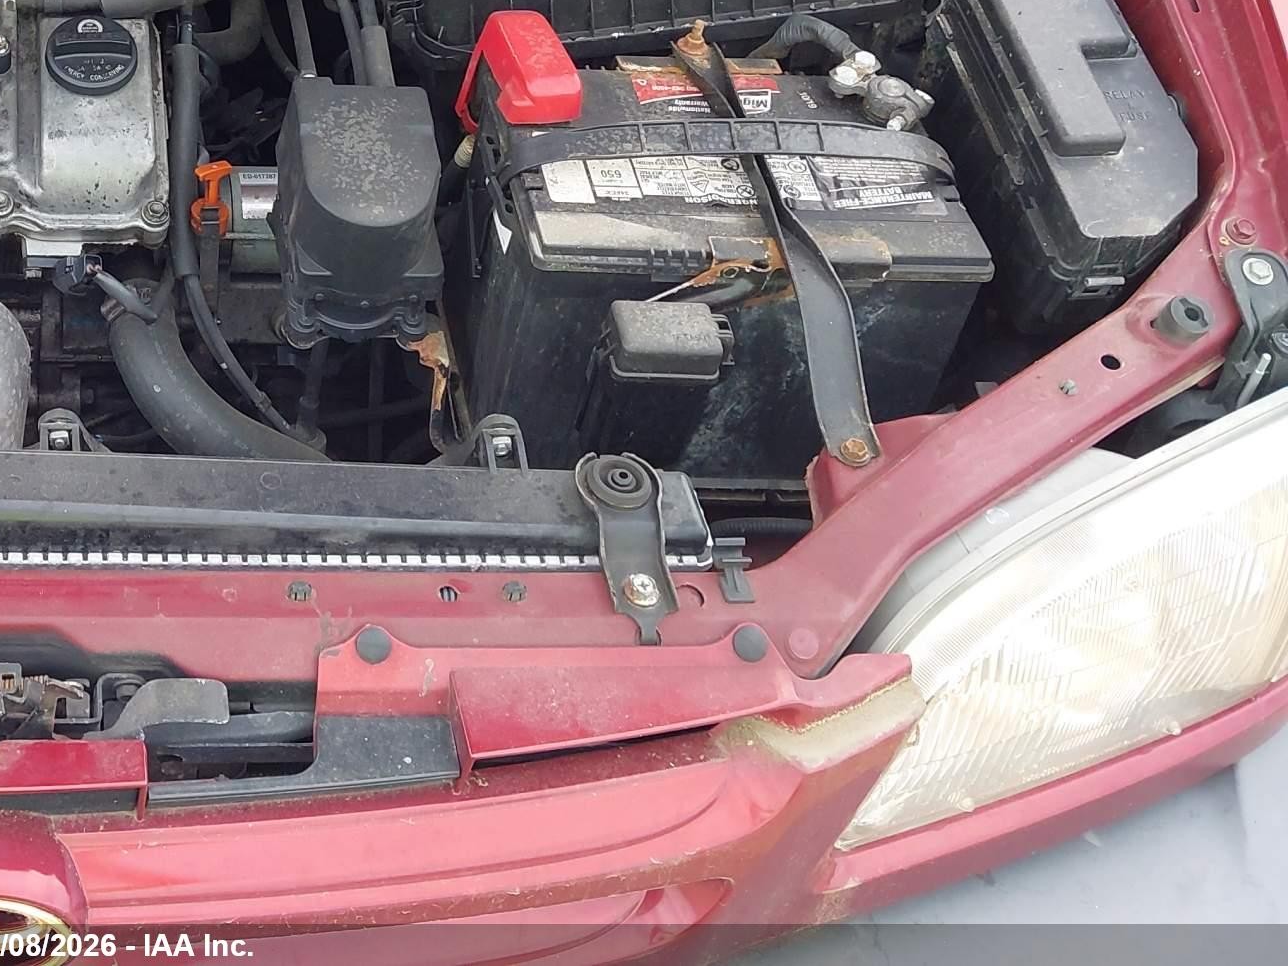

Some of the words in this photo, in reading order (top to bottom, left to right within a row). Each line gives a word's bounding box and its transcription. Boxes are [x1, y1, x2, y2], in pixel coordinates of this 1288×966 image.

[1102, 89, 1145, 100] RELAY
[674, 99, 710, 107] Warranty
[668, 105, 711, 114] Nationwide
[600, 169, 622, 179] 650
[858, 186, 903, 198] BATTERY
[833, 191, 934, 208] MAINTENANCE-FREE
